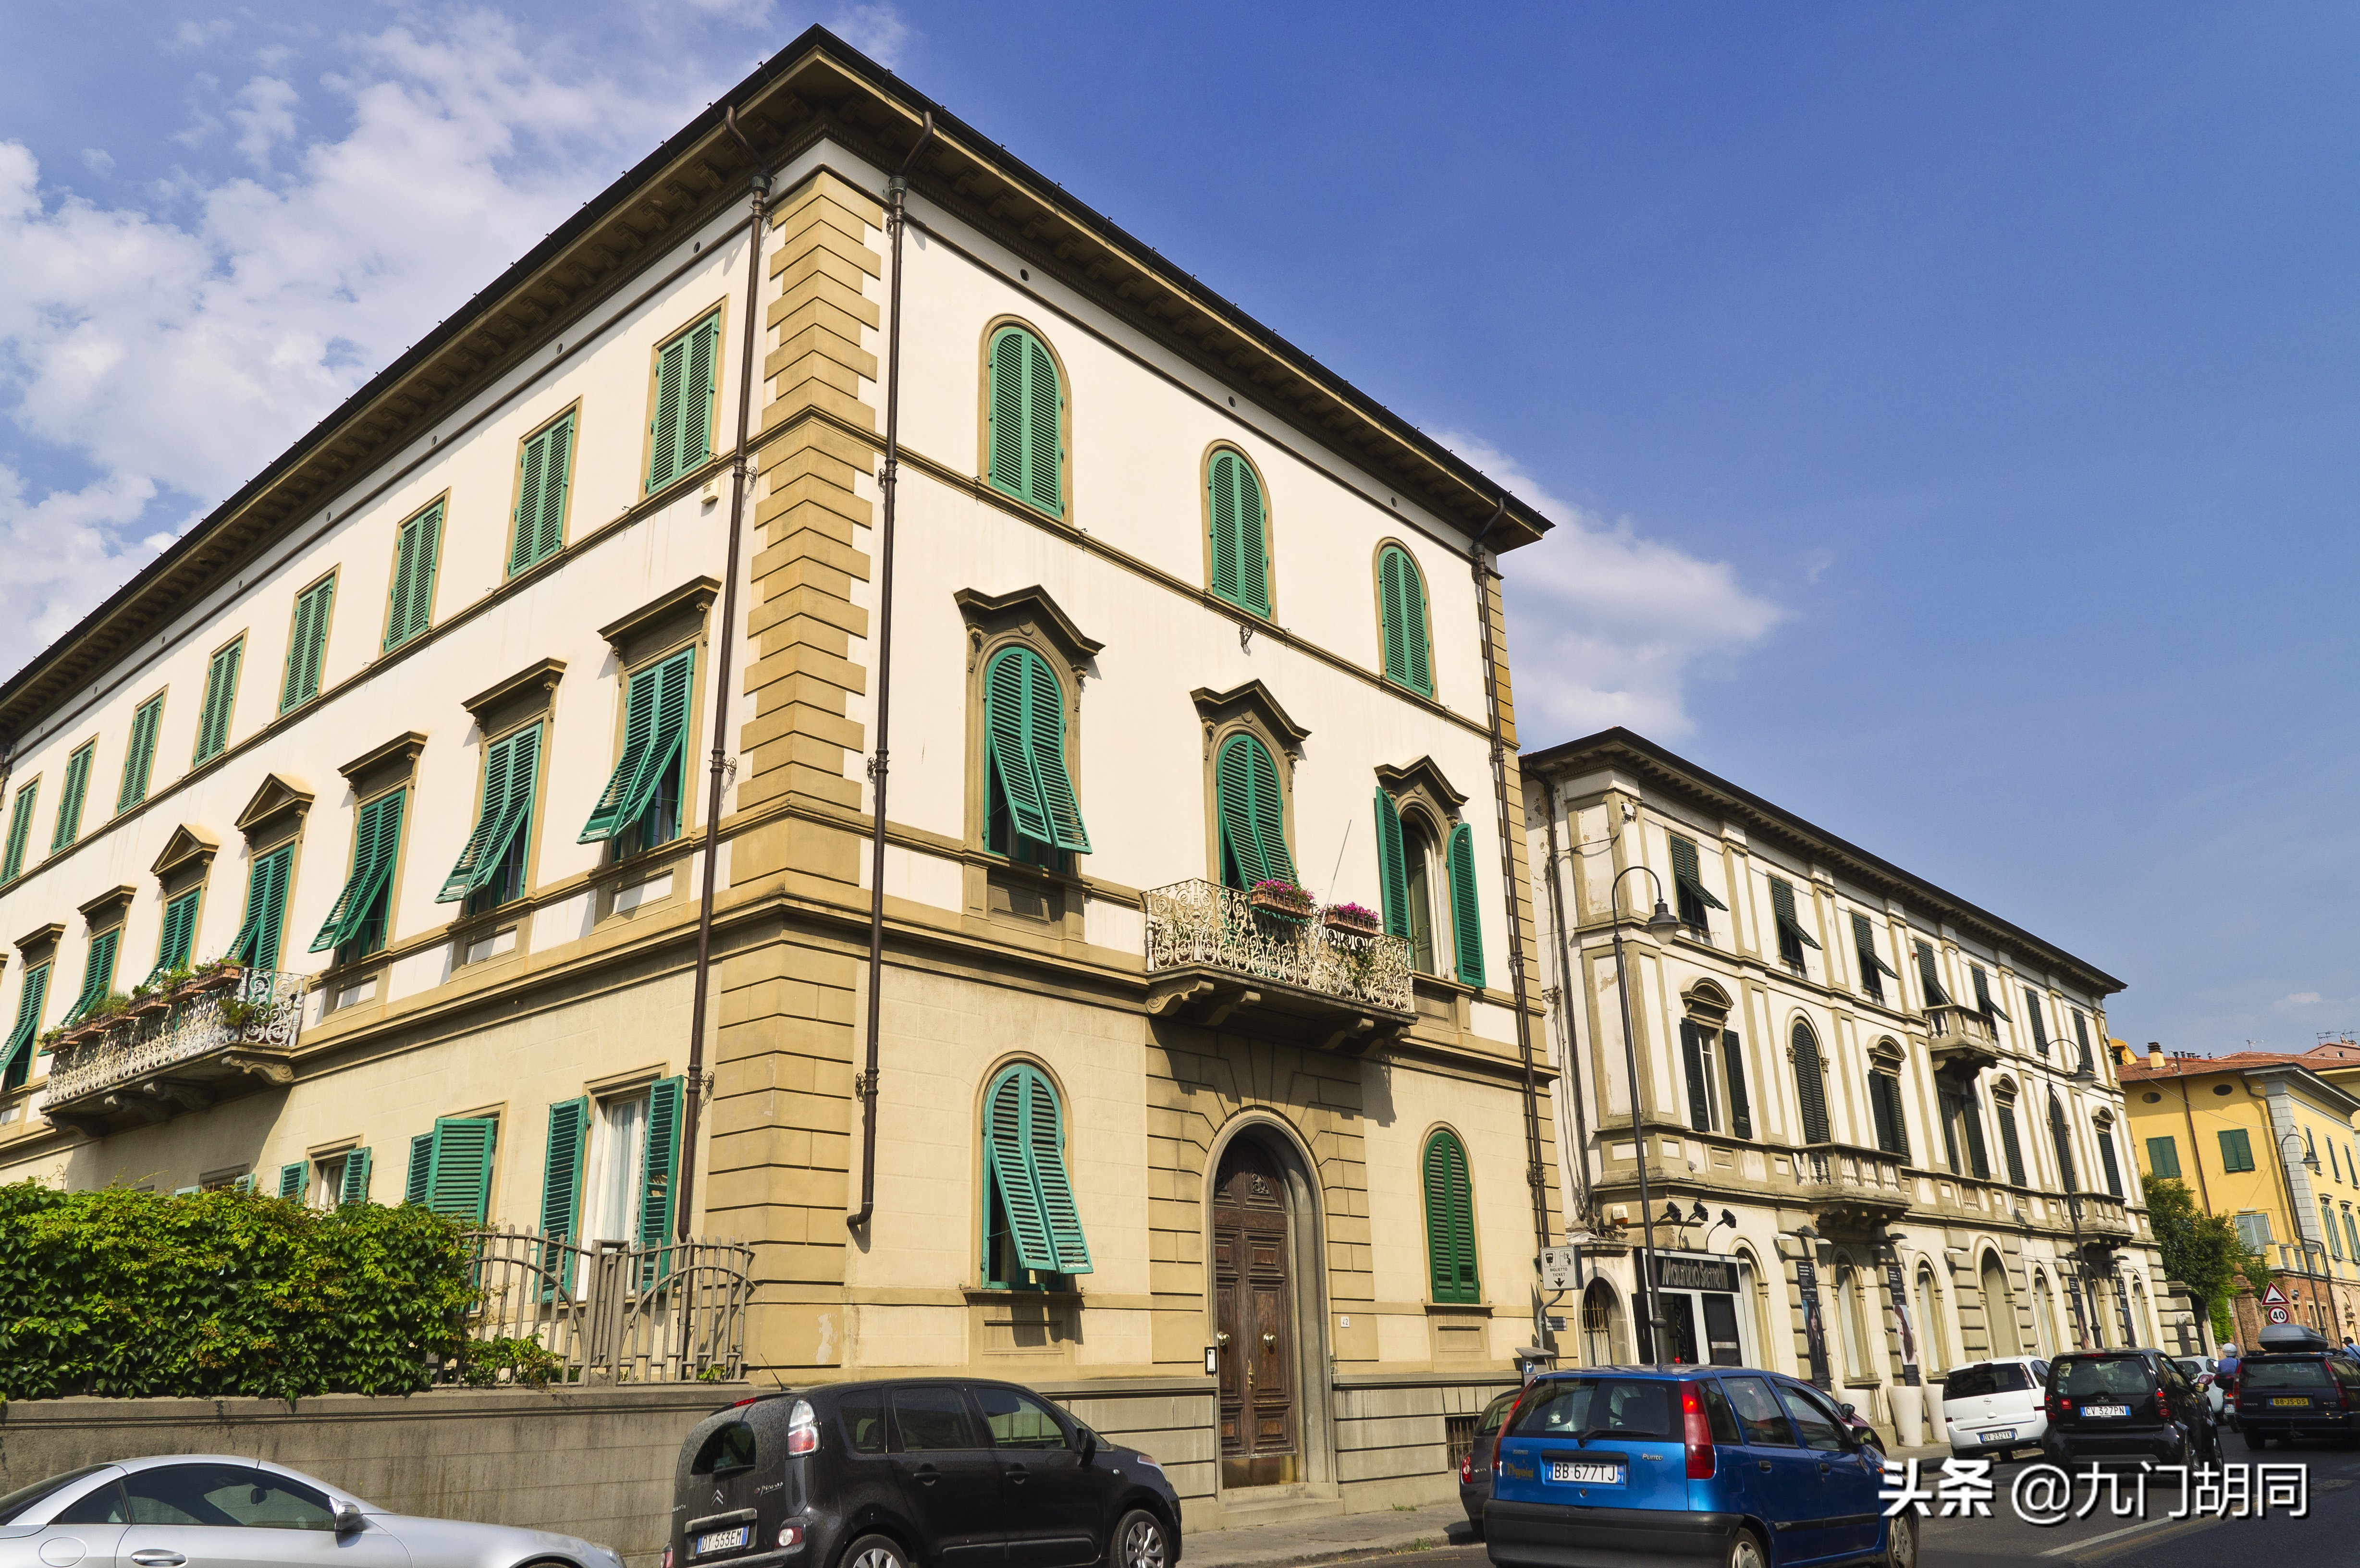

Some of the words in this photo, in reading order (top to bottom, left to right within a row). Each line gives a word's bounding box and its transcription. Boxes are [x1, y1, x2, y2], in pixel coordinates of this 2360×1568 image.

[1662, 1259, 1700, 1287] Maurizio
[2273, 1311, 2285, 1320] 40
[1526, 1361, 1532, 1373] P
[2086, 1407, 2095, 1415] CV
[2099, 1406, 2125, 1415] 327PN
[1555, 1463, 1569, 1479] BB
[1574, 1464, 1615, 1481] 677TJ
[702, 1535, 712, 1551] DY
[715, 1529, 742, 1548] 553EM
